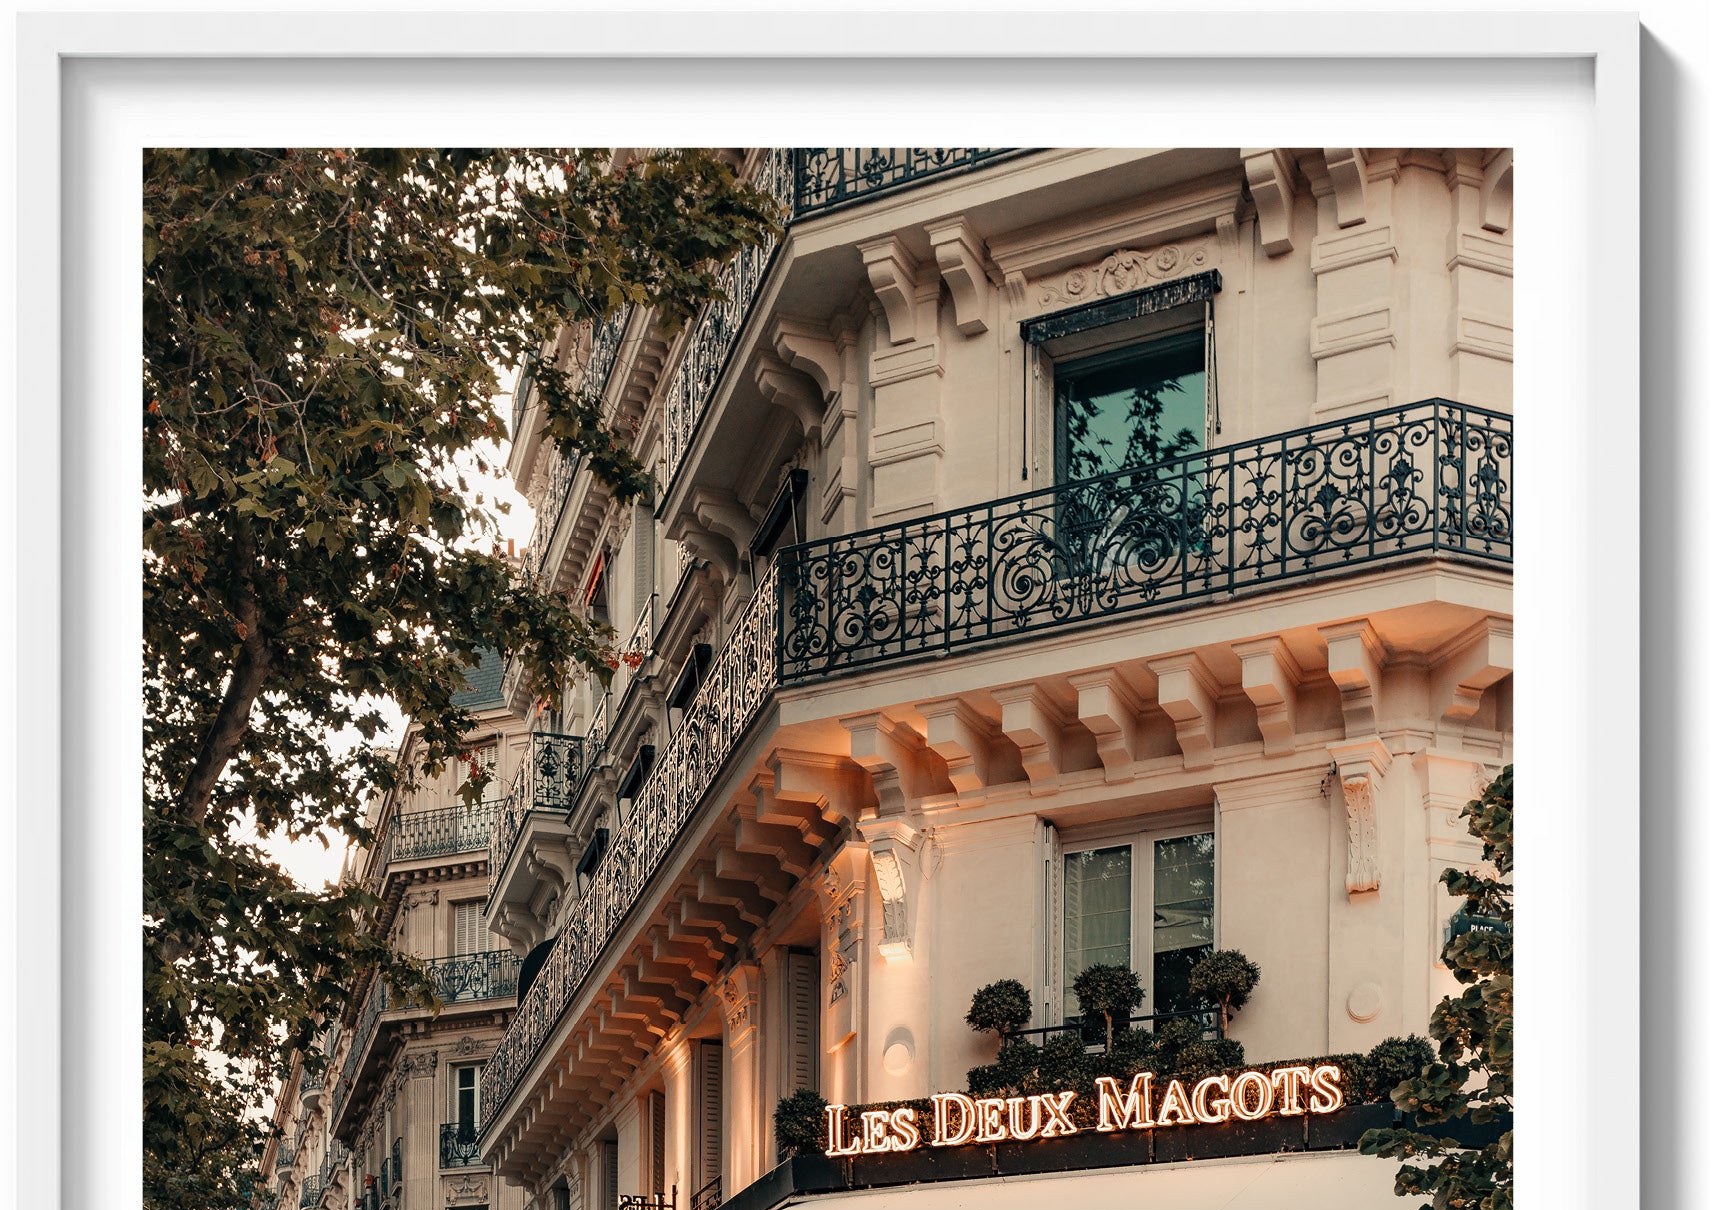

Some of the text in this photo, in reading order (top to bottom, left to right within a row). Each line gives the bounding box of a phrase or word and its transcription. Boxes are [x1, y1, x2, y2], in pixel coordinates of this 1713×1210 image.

[825, 1065, 1346, 1156] LES DEUX MAGOTS
